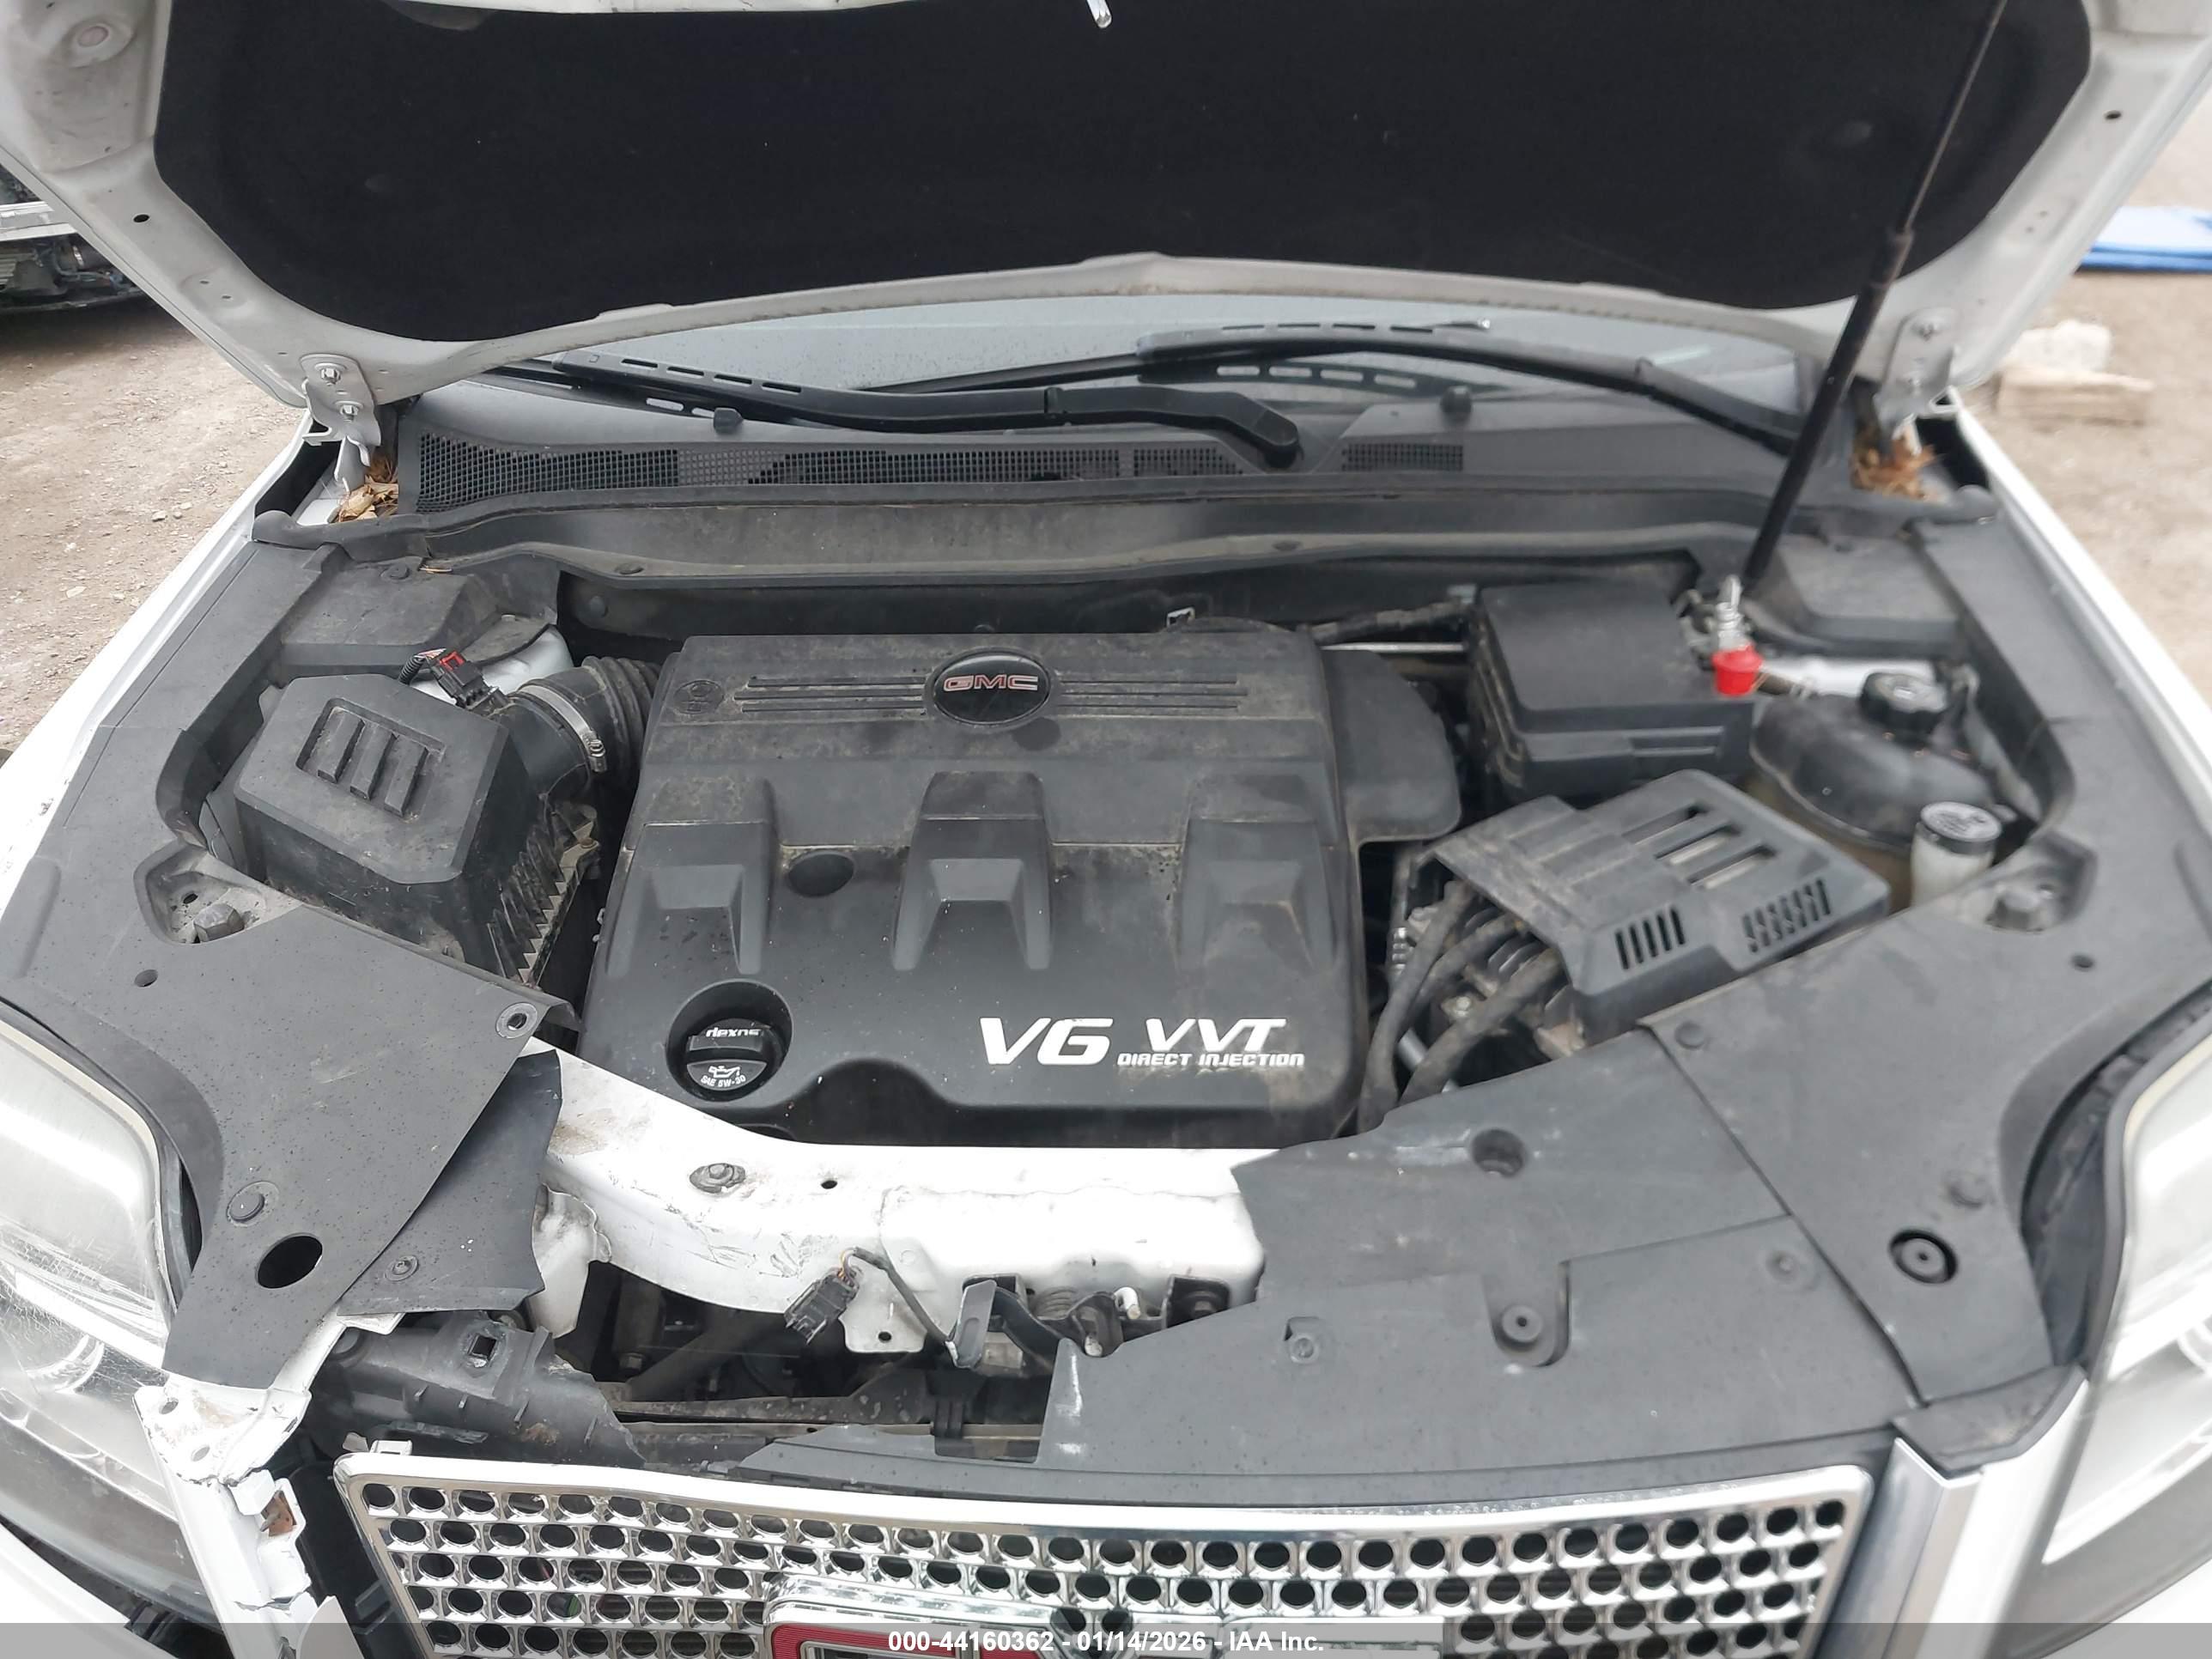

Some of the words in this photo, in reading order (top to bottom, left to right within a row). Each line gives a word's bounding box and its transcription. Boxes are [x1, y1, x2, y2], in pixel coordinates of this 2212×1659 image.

[944, 674, 1038, 691] GMC
[980, 1018, 1114, 1065] V6
[1146, 1018, 1286, 1052] VVT
[1117, 1053, 1193, 1066] DIRECT
[1198, 1053, 1304, 1067] INJECTION
[700, 1075, 716, 1087] SAE
[717, 1074, 746, 1088] 5W-30
